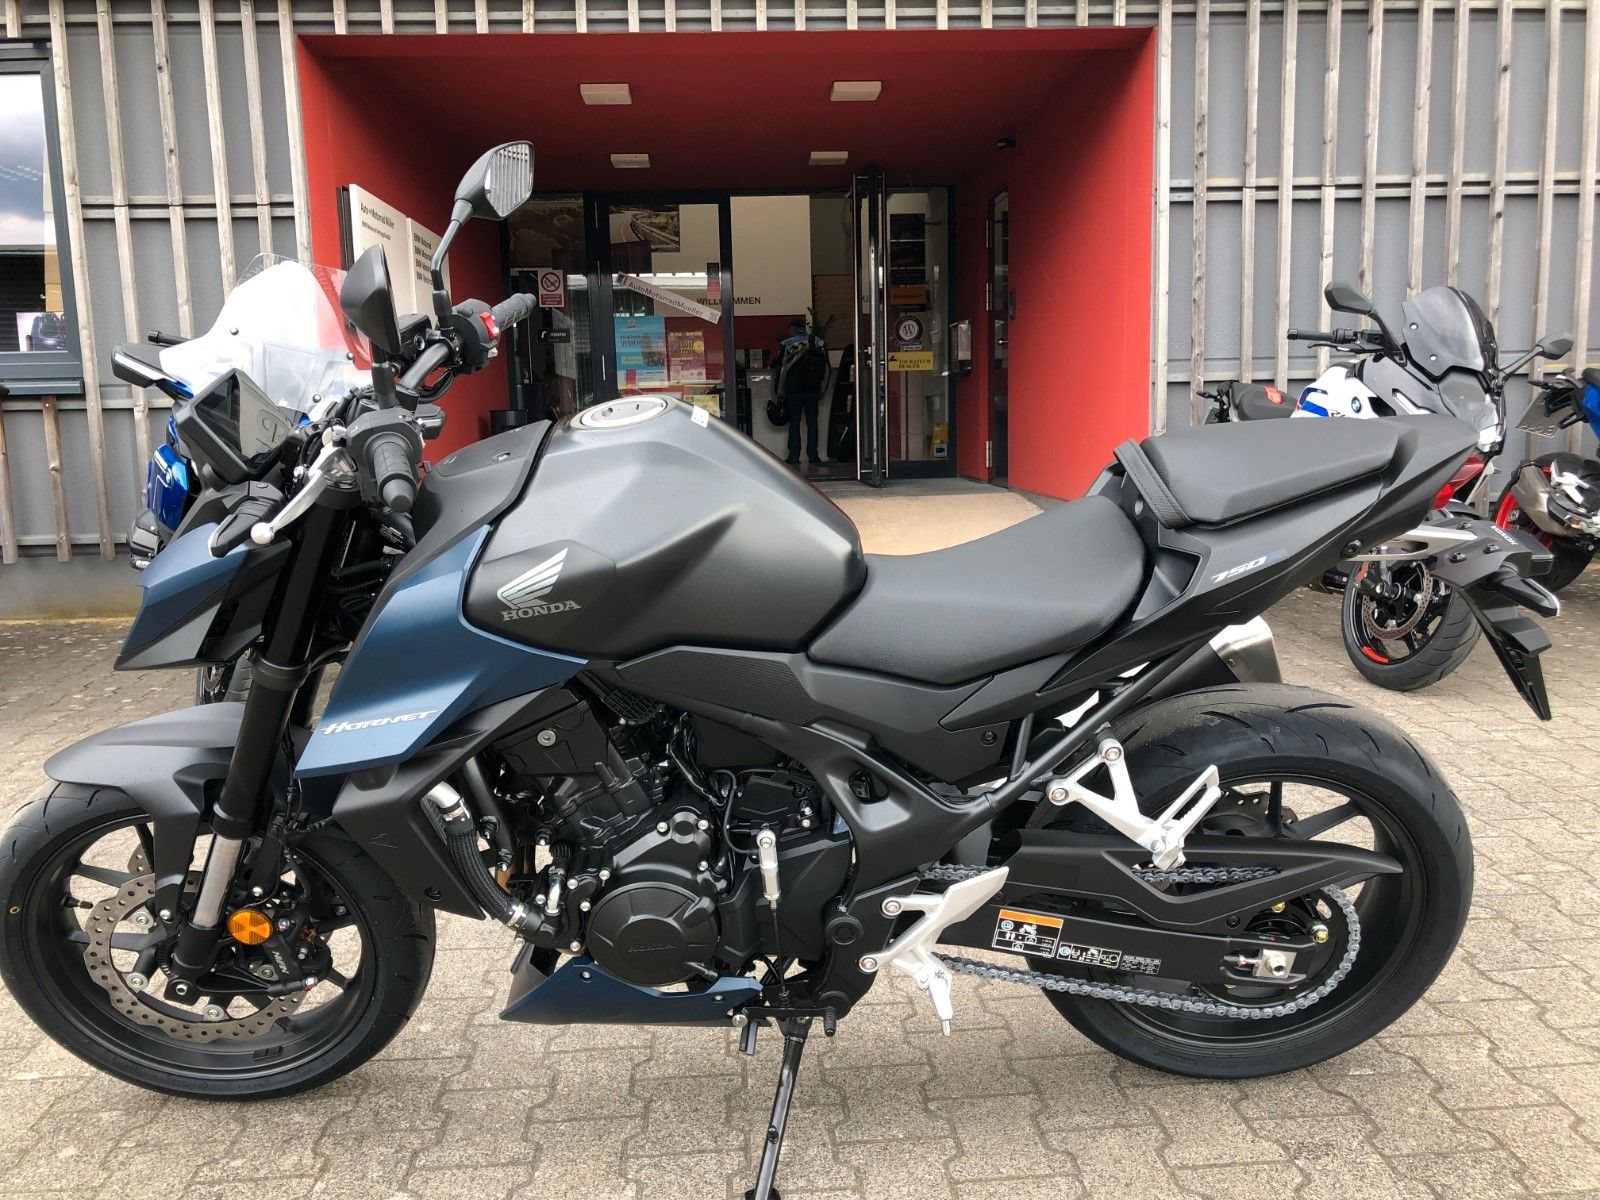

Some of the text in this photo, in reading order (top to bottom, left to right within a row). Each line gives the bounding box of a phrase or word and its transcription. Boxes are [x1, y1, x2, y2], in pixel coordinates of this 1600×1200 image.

[1210, 555, 1268, 584] 750
[501, 599, 581, 621] HONDA
[319, 709, 440, 735] HORNET
